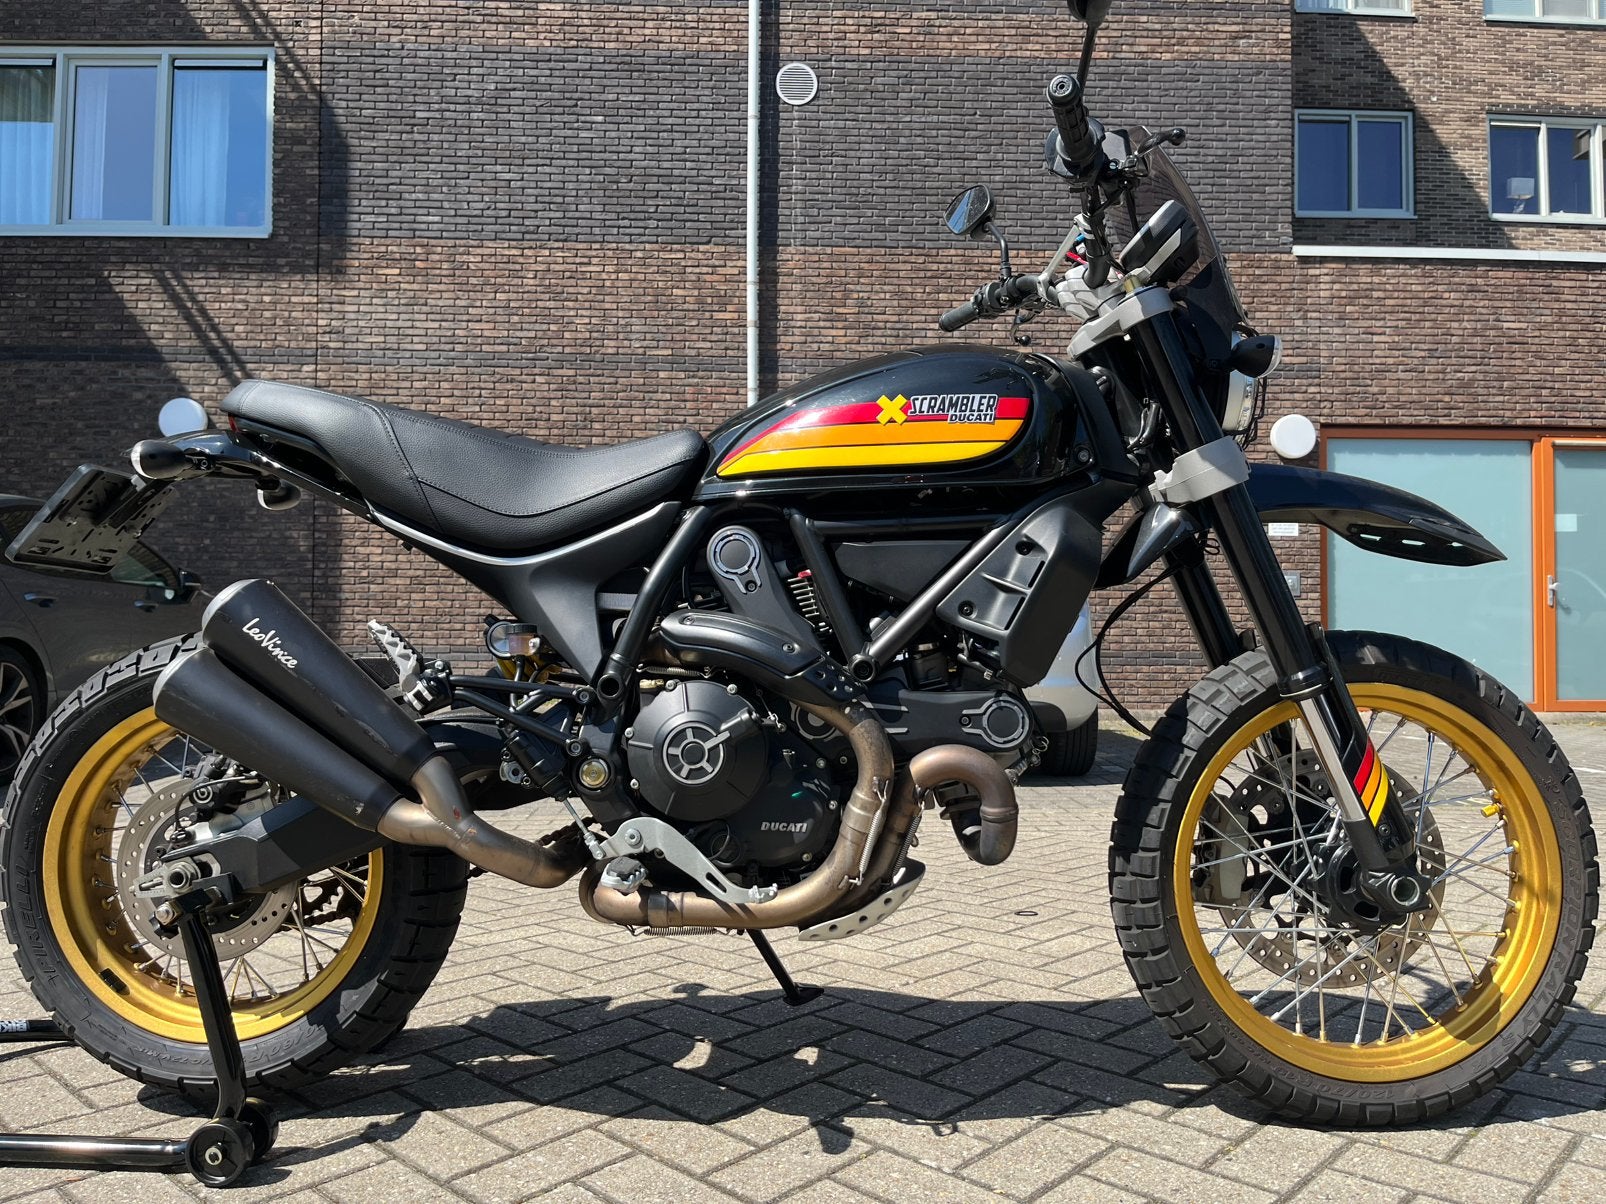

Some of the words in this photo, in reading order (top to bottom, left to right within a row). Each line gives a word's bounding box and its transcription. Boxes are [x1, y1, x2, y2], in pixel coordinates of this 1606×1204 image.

[908, 394, 997, 414] SCRAMBLER
[949, 413, 993, 422] DUCATI
[242, 618, 297, 668] LeoVince
[761, 822, 807, 832] DUCATI
[16, 864, 56, 976] PIRELLI
[0, 1020, 27, 1032] BIK
